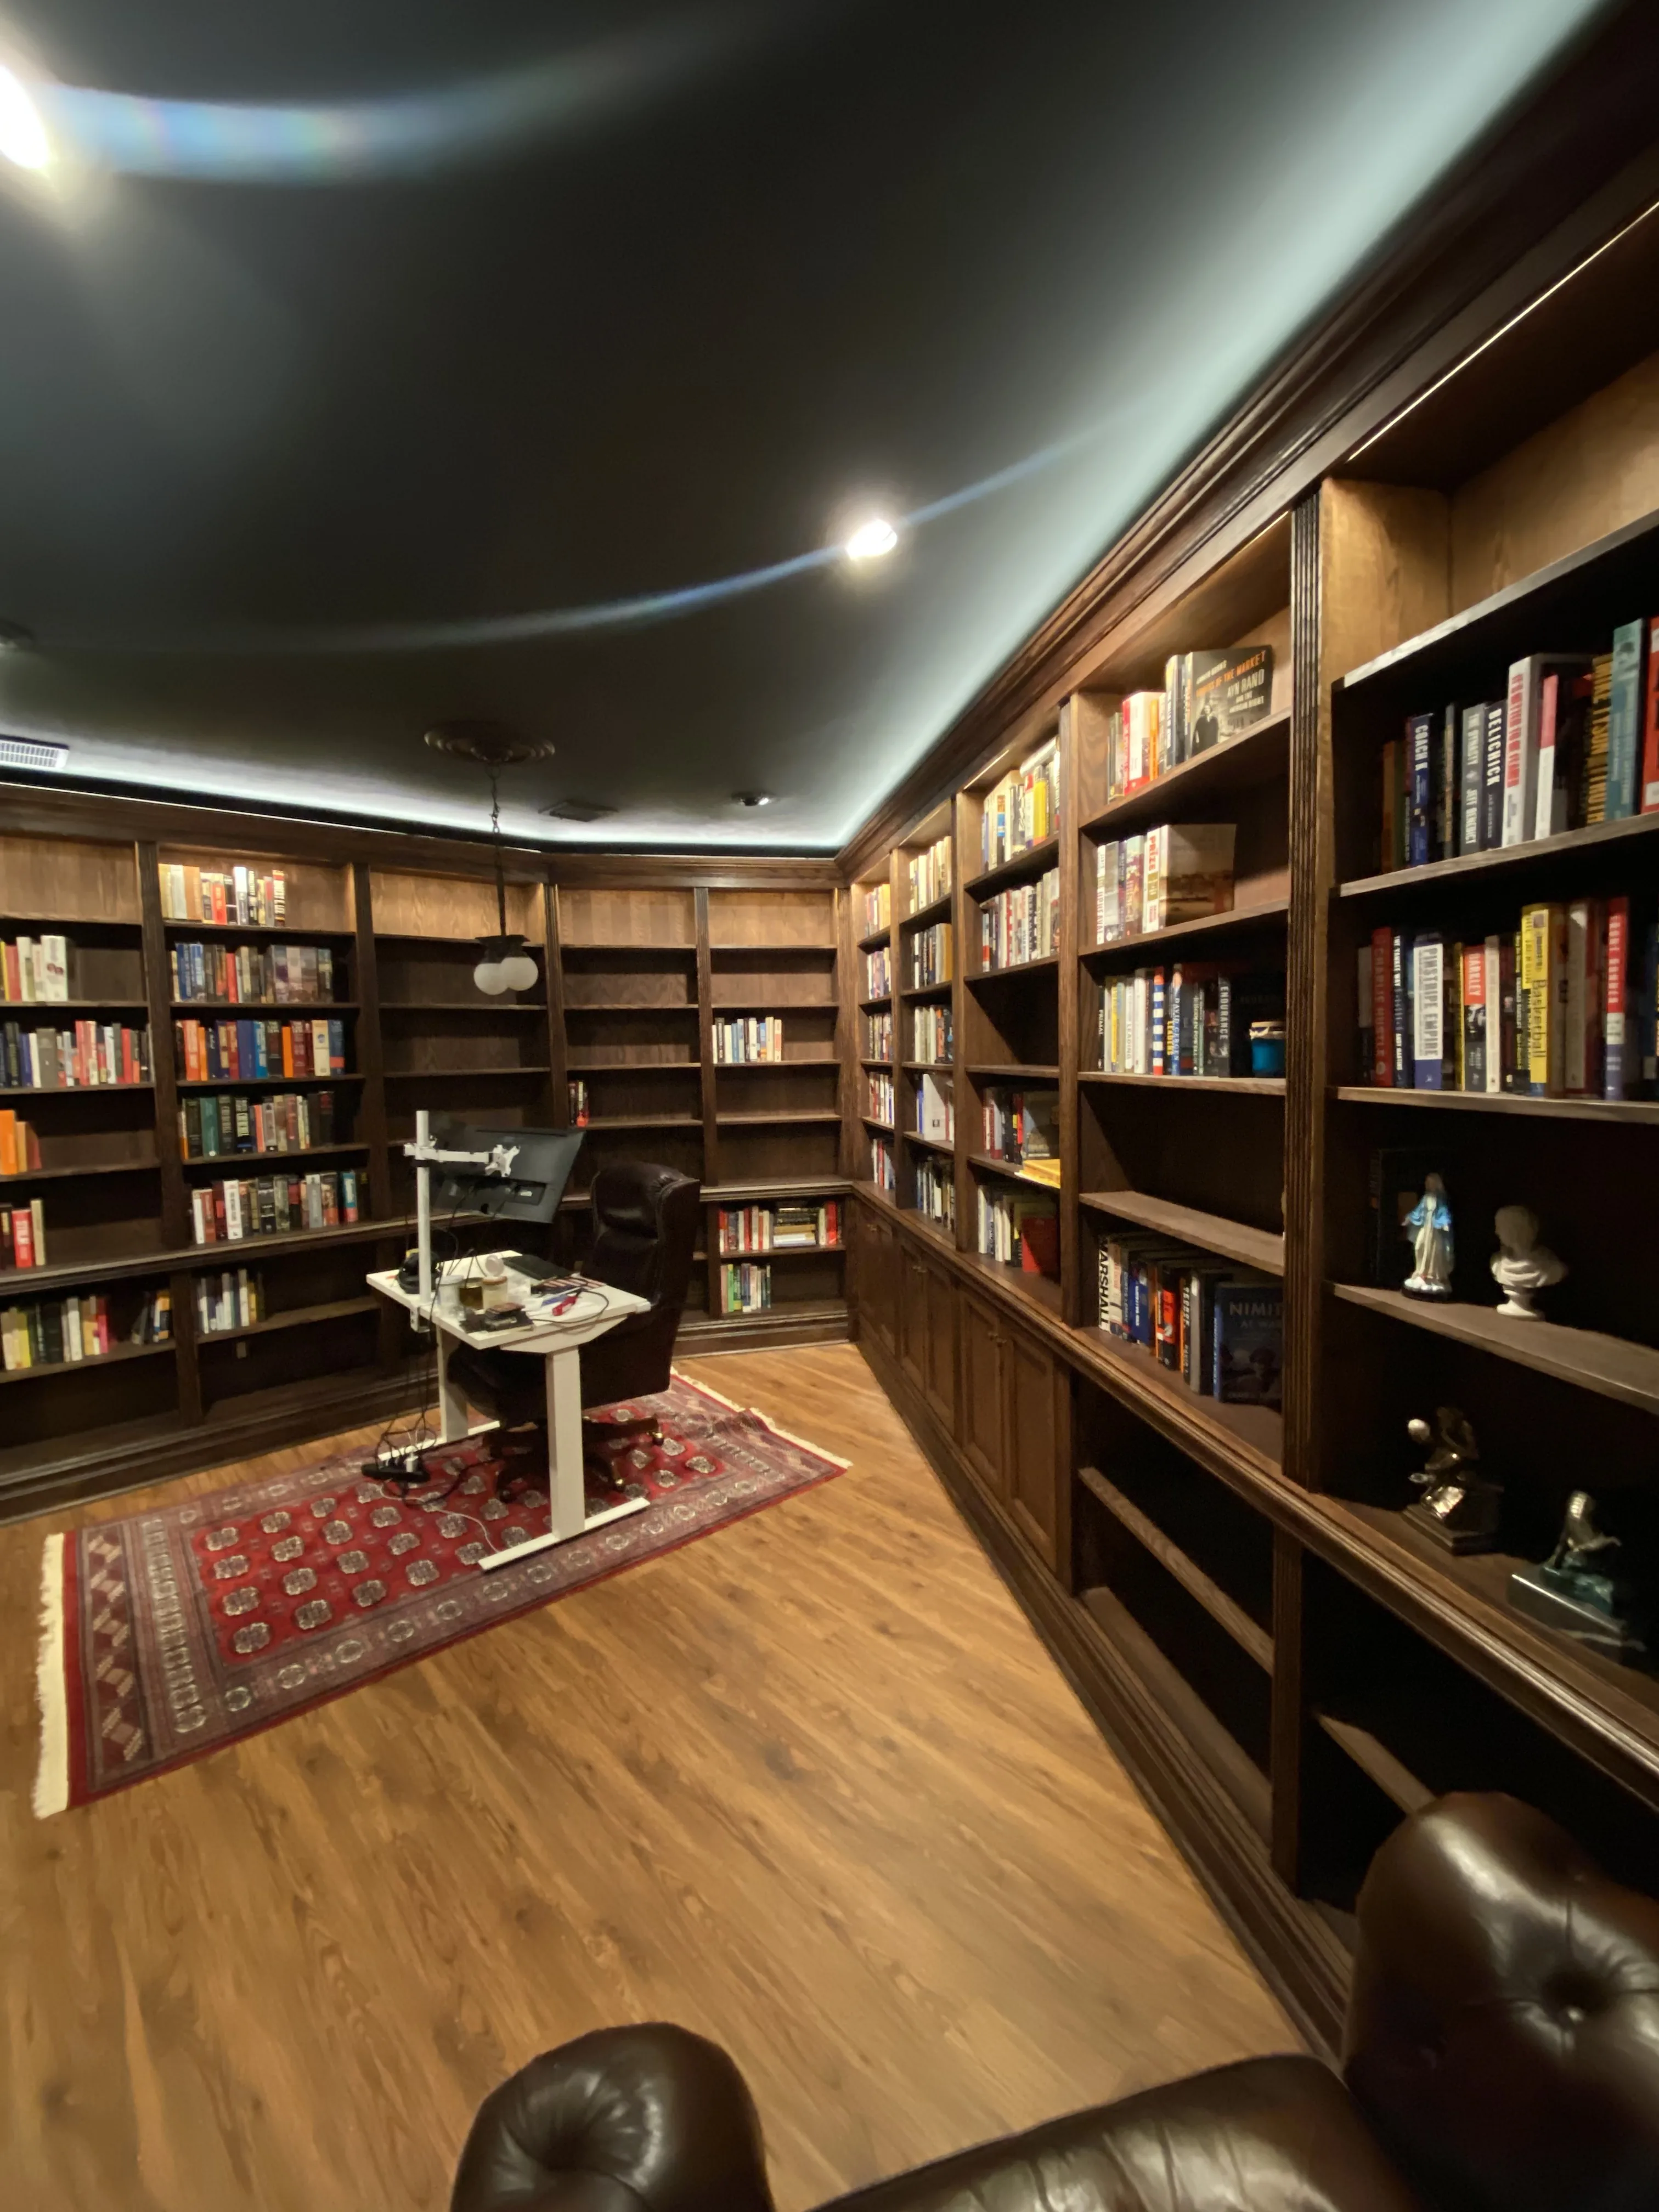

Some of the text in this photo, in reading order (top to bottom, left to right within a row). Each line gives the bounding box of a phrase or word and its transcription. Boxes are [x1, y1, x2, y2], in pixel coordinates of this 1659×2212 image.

[1236, 650, 1266, 676] MARKET
[1227, 669, 1265, 698] AYN RAND
[1414, 725, 1428, 760] COACH
[1467, 730, 1480, 765] DYNASTY
[1486, 708, 1502, 786] BELICHICK
[1591, 706, 1612, 754] TYSON
[1415, 762, 1428, 771] K
[1465, 808, 1477, 844] BENEDICT
[1149, 835, 1158, 871] PRIZE
[1468, 953, 1482, 997] BARKLEY
[1220, 986, 1229, 1040] ENDURANCE
[1374, 948, 1385, 1057] CHARLIE HUSTLE
[1423, 948, 1438, 1056] PINSTRIPE EMPIRE
[1532, 979, 1547, 1058] Basketball
[1099, 1238, 1109, 1328] MARSHALL
[1229, 1301, 1283, 1317] NIMIT
